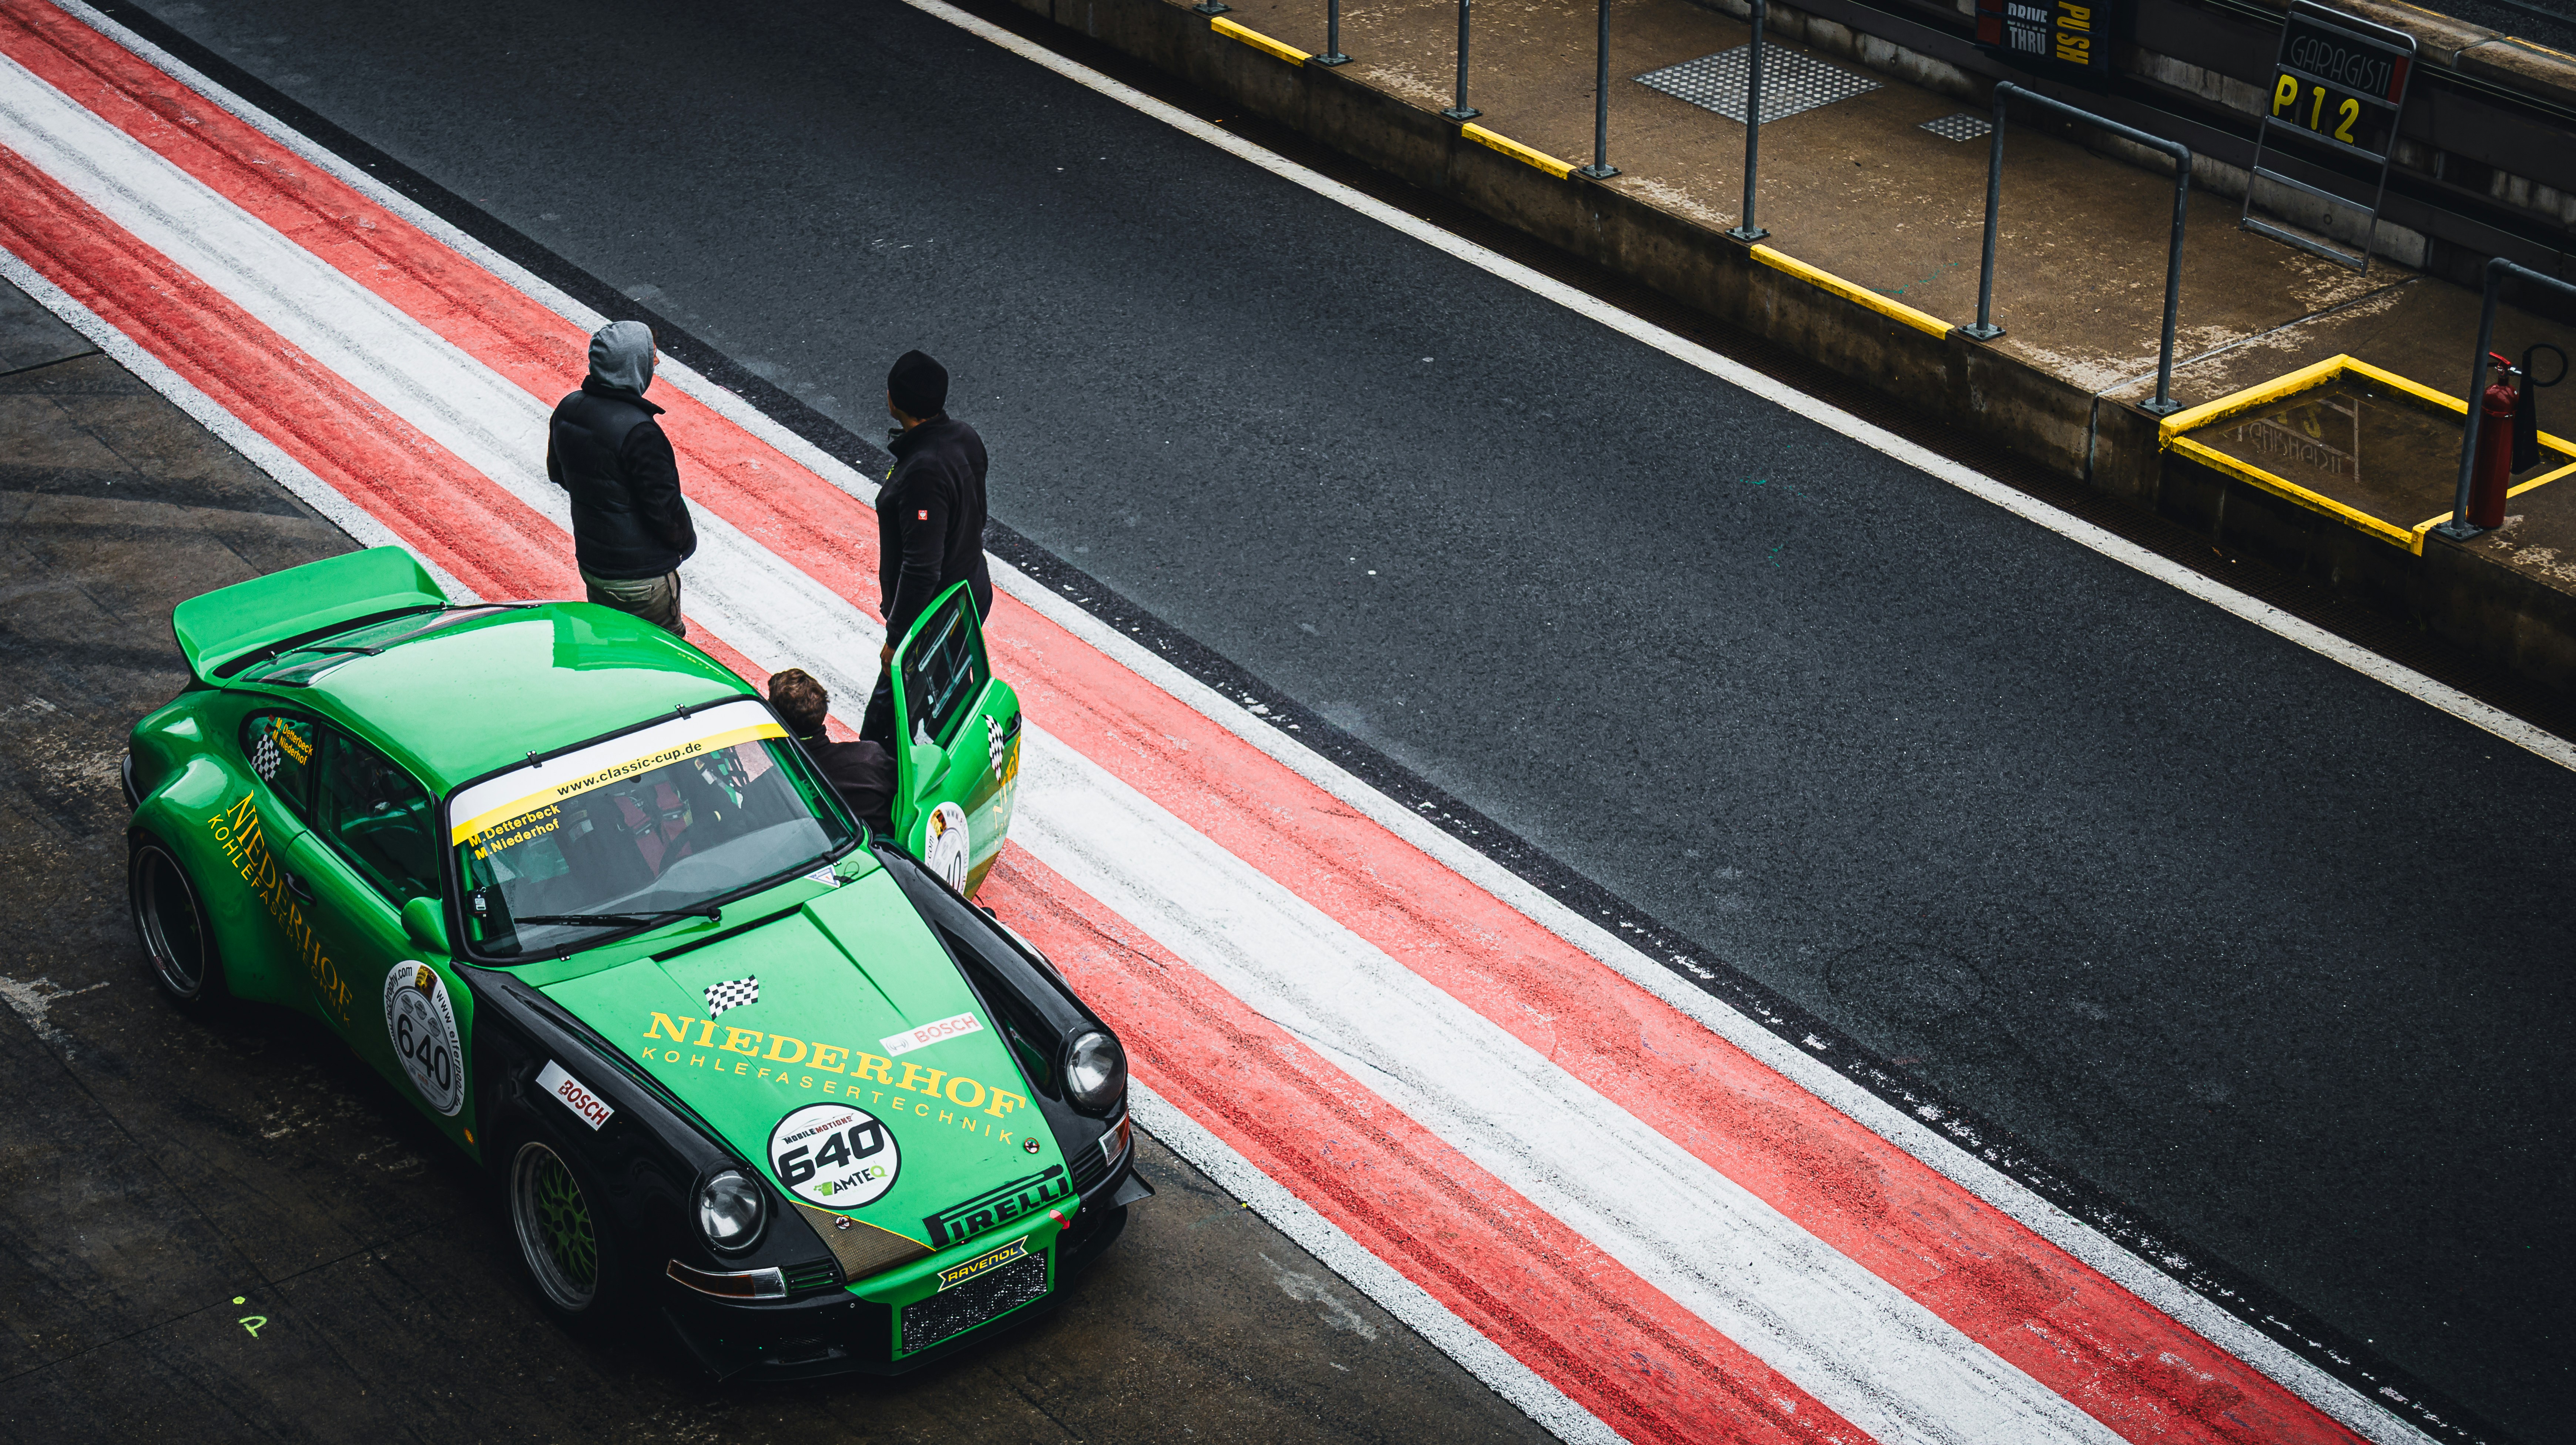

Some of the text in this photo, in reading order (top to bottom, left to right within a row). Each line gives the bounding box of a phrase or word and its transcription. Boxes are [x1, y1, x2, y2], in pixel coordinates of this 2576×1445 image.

[2008, 2, 2047, 33] DRIVE
[2009, 27, 2046, 55] THRU
[2056, 1, 2090, 65] PUSH
[2291, 36, 2391, 95] GARAGISTI
[272, 730, 308, 765] M. Niederhof
[276, 718, 313, 756] M. Detterbeck
[557, 742, 702, 796] www.classic-cup.de
[208, 814, 350, 1028] KOHLEFASERTECHNIK
[226, 789, 352, 1005] NIEDERHOF
[397, 1013, 450, 1091] 640
[436, 990, 463, 1107] www.elferpoolde
[914, 1016, 979, 1043] BOSCH
[643, 1012, 1026, 1118] NIEDERHOF
[557, 1079, 610, 1126] BOSCH
[642, 1047, 1013, 1145] KOHLEFASERTECHNIK
[778, 1119, 884, 1187] 640
[833, 1165, 888, 1194] AMTEQ
[922, 1163, 1070, 1248] PIRELLI
[948, 1247, 1019, 1282] RAVENOL
